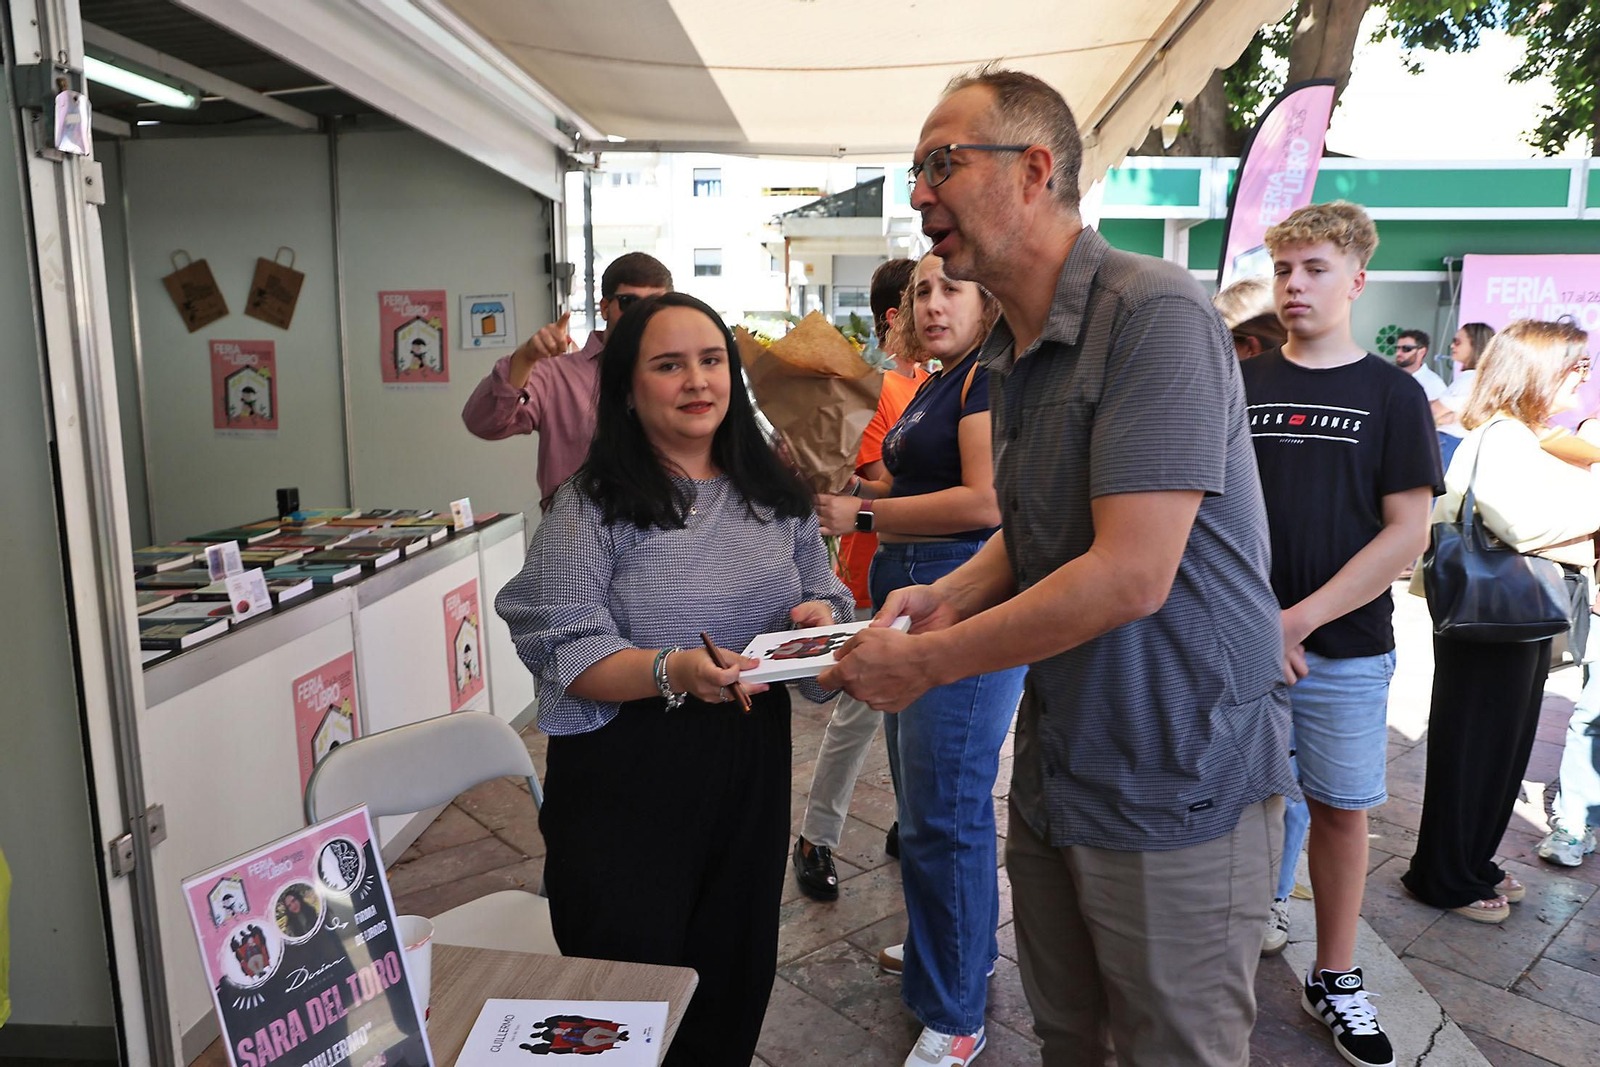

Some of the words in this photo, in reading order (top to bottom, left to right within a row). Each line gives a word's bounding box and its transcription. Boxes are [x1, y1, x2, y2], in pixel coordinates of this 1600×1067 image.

[1284, 139, 1310, 195] LIBRO
[1259, 171, 1286, 226] FERIA
[383, 294, 411, 307] FERIA
[1486, 276, 1558, 304] FERIA
[1561, 291, 1574, 303] 17
[1576, 290, 1586, 303] al
[1251, 413, 1283, 426] ACK
[1311, 415, 1361, 432] JONES
[298, 674, 324, 703] FERIA
[314, 683, 340, 713] LIBRO
[247, 857, 276, 878] FERIA
[266, 859, 294, 880] LIBRO
[237, 1008, 308, 1067] SARA
[305, 984, 349, 1036] DEL
[345, 950, 402, 1008] TORO
[301, 1021, 373, 1067] UILLERMO"
[490, 1013, 515, 1054] GUILLERMO
